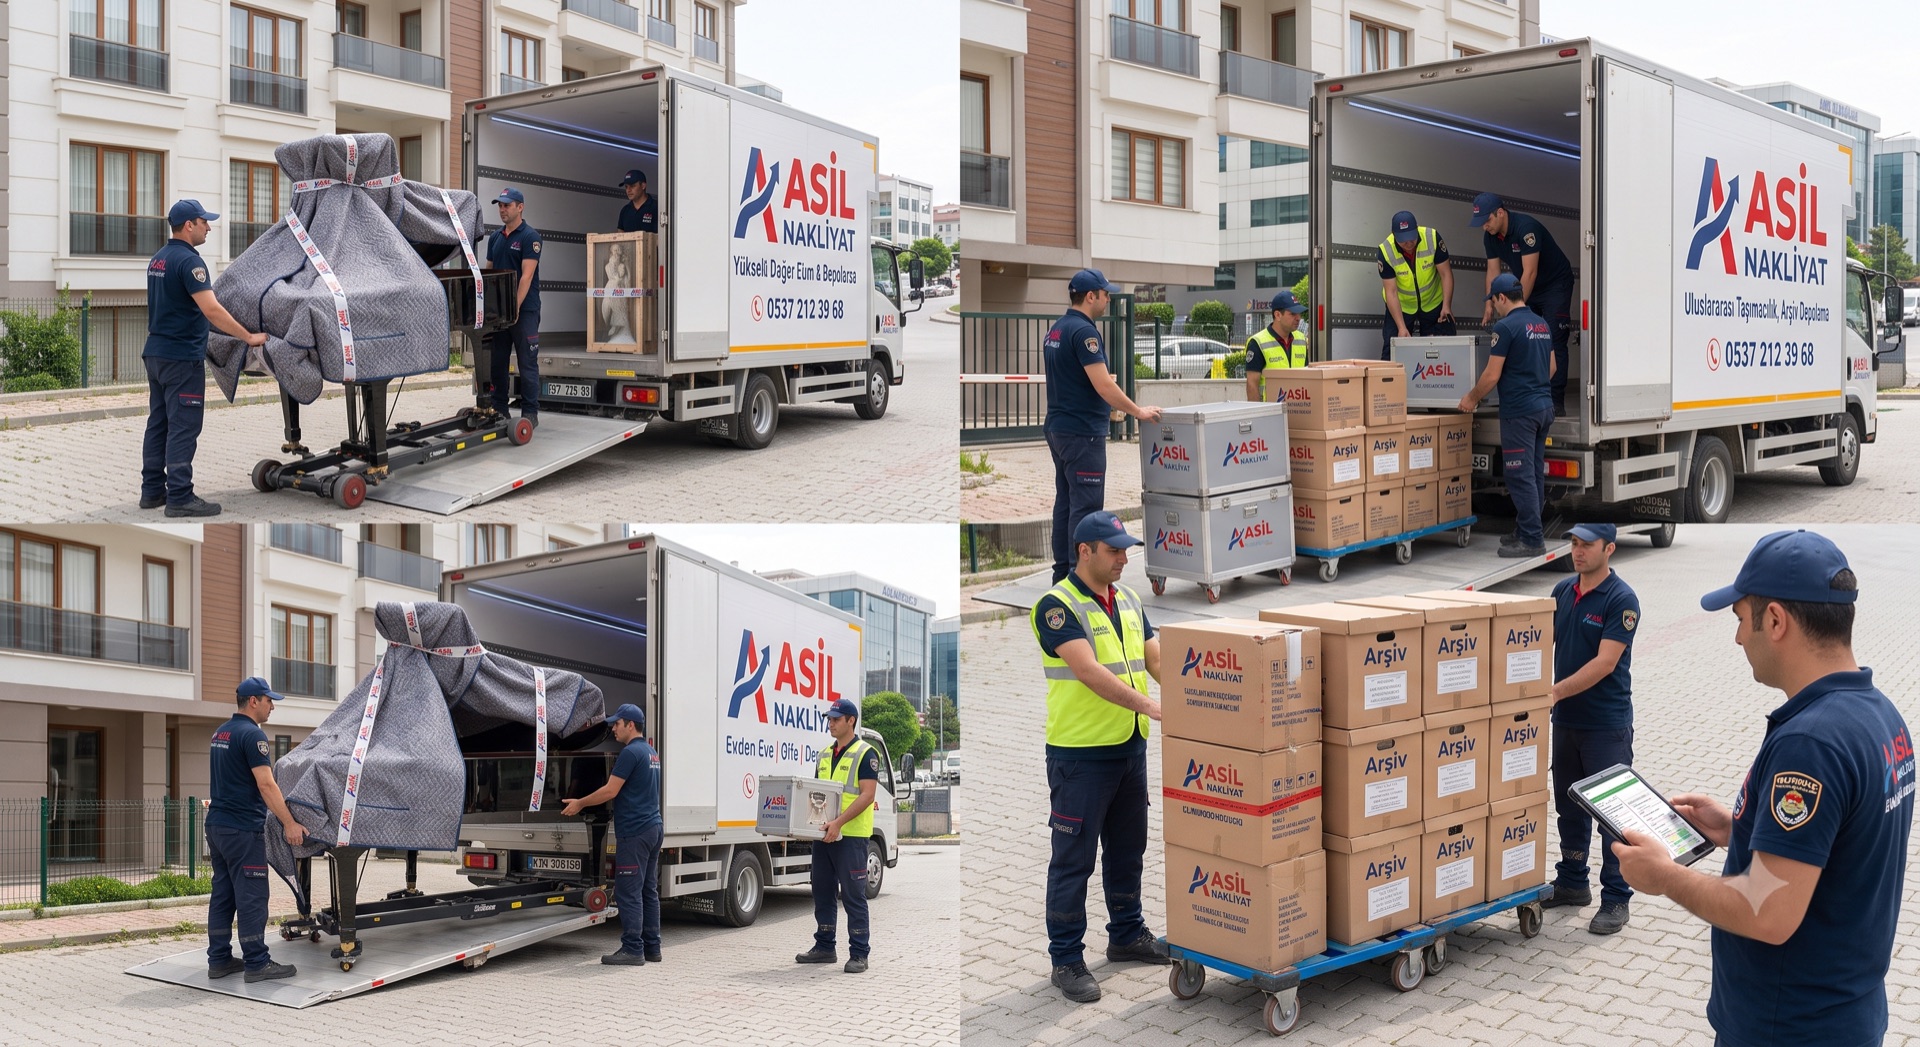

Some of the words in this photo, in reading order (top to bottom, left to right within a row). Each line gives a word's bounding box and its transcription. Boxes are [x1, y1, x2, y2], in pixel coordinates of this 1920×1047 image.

[783, 151, 855, 220] ASİL
[1744, 162, 1827, 247] ASİL
[784, 219, 855, 252] NAKLİYAT
[771, 259, 794, 284] Dağer
[816, 264, 821, 281] &
[823, 264, 856, 286] Bepolarsa
[1744, 245, 1828, 286] NAKLİYAT
[767, 298, 794, 319] 0537
[797, 299, 815, 319] 212
[818, 299, 829, 319] 39
[832, 300, 844, 319] 68
[1684, 292, 1734, 317] Uluslararası
[1781, 300, 1798, 325] Arşiv
[1800, 302, 1829, 325] Depolama
[1725, 341, 1756, 367] 0537
[1760, 341, 1781, 367] 212
[1785, 342, 1798, 366] 39
[1801, 342, 1814, 366] 68
[1426, 362, 1454, 376] ASİL
[1287, 387, 1311, 400] ASİL
[1239, 437, 1268, 454] ASİL
[1373, 438, 1397, 454] Arşiv
[1409, 433, 1432, 449] Arşiv
[1446, 429, 1467, 444] Arşiv
[1163, 444, 1189, 461] ASİL
[1240, 453, 1269, 465] NAKLİYAT
[1289, 445, 1314, 459] ASİL
[1333, 444, 1358, 460] Arşiv
[1164, 462, 1190, 472] NAKLİYAT
[1445, 483, 1467, 499] Arşiv
[1168, 530, 1193, 546] ASİL
[1245, 520, 1273, 539] ASİL
[1438, 632, 1477, 657] Arşiv
[1506, 625, 1542, 648] Arşiv
[1203, 648, 1243, 671] ASİL
[1364, 643, 1407, 668] Arşiv
[774, 637, 841, 702] ASİL
[1203, 670, 1243, 684] NAKLİYAT
[1503, 723, 1539, 745] Arşiv
[759, 738, 774, 759] Eve
[1437, 735, 1476, 758] Arşiv
[1365, 751, 1408, 775] Arşiv
[1204, 764, 1244, 787] ASİL
[1206, 783, 1244, 798] NAKLİYAT
[1502, 818, 1538, 842] Arşiv
[1436, 834, 1475, 858] Arşiv
[1365, 854, 1407, 879] Arşiv
[1211, 871, 1250, 896] ASİL
[1211, 889, 1251, 908] NAKLİYAT
